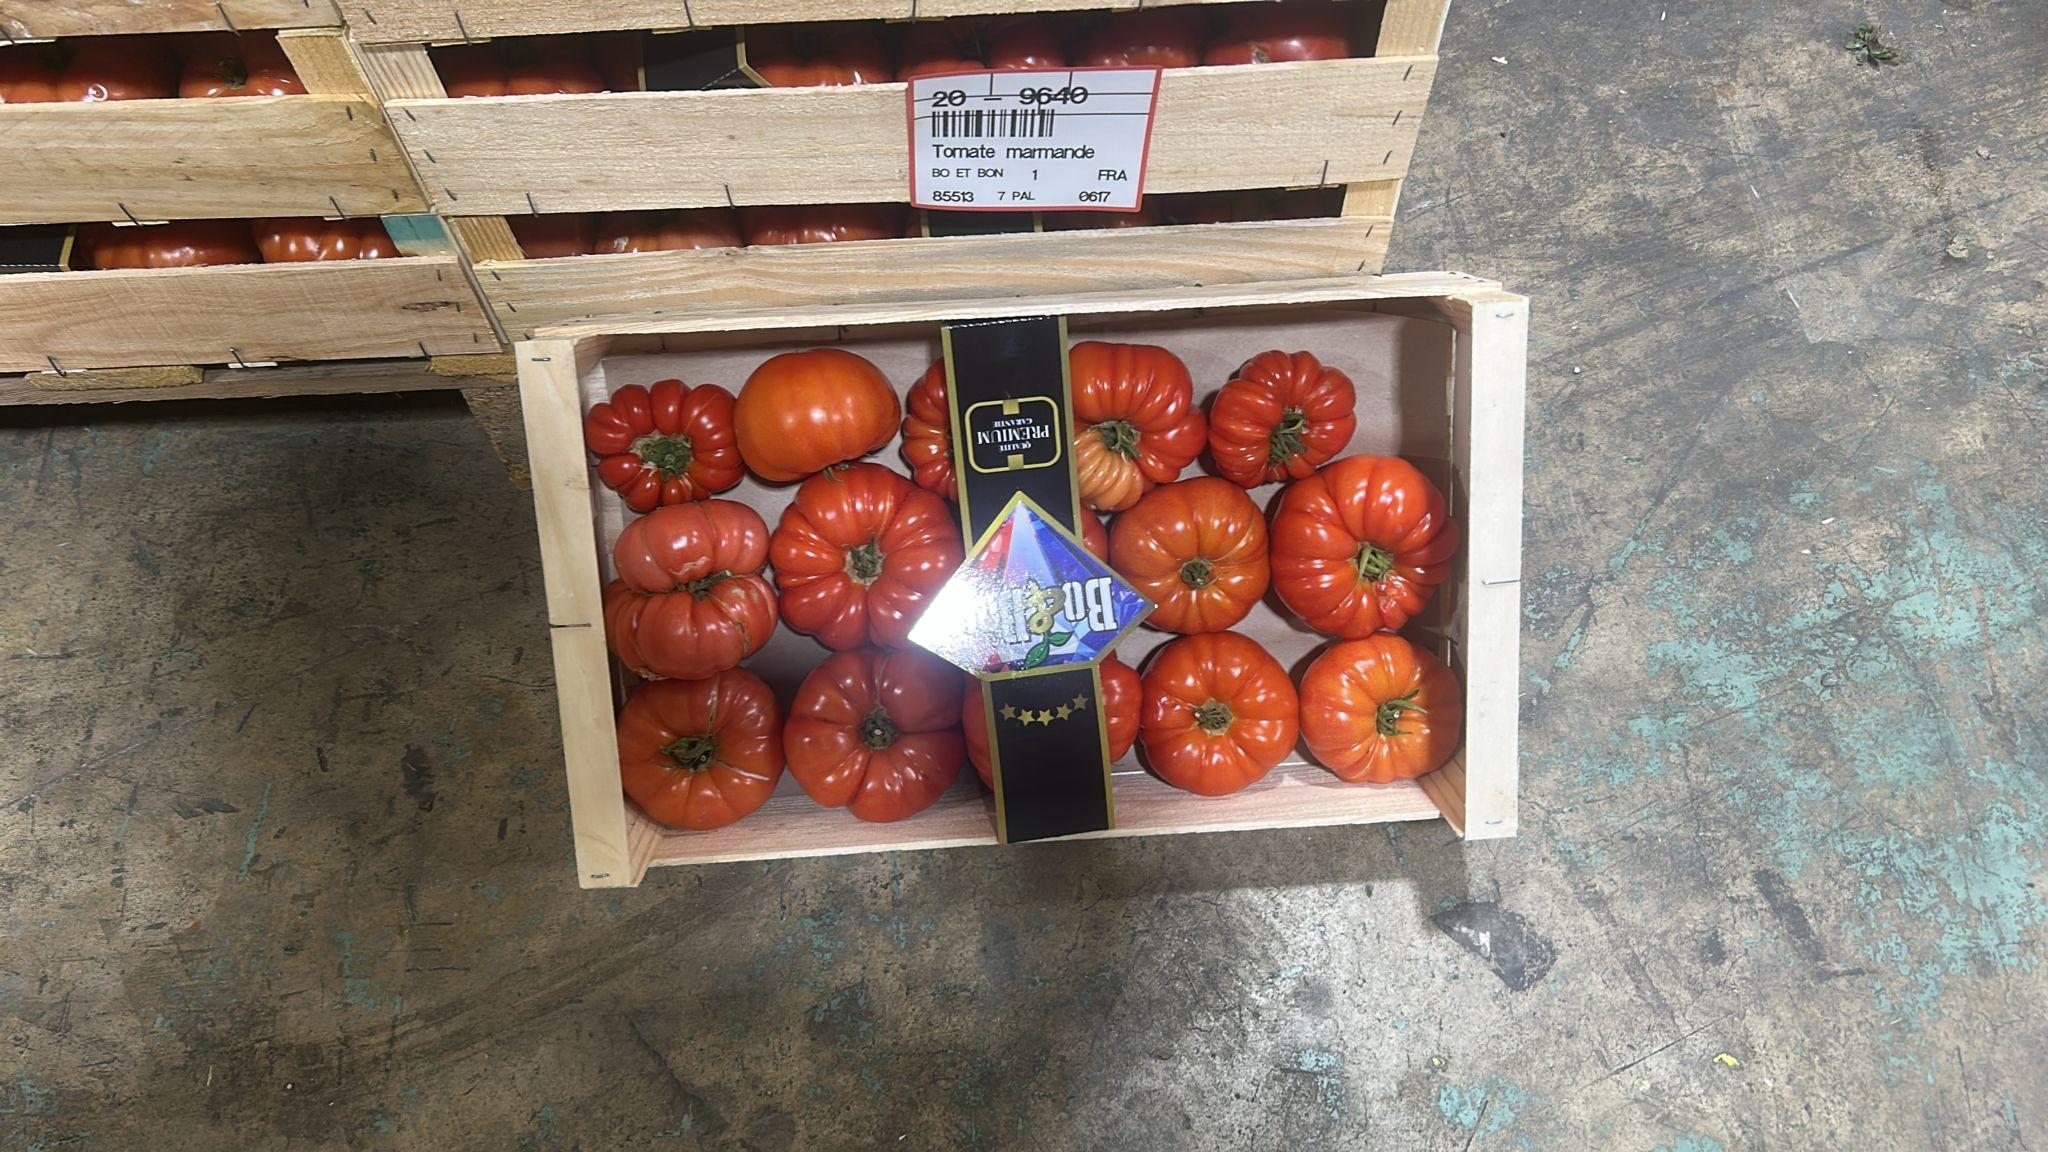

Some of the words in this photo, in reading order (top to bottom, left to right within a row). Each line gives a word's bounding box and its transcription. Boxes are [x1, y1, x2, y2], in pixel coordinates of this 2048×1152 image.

[931, 89, 967, 108] 20
[1018, 86, 1089, 106] 9640
[932, 144, 996, 159] Tomate
[1006, 144, 1095, 159] marmande
[932, 168, 950, 178] BO
[956, 168, 971, 178] ET
[977, 168, 1004, 178] BON
[1032, 169, 1039, 181] 1
[1097, 169, 1128, 181] FRA
[932, 190, 975, 203] 85513
[998, 191, 1005, 201] 7
[1012, 191, 1036, 201] PAL
[1078, 190, 1112, 203] 0617
[977, 425, 1050, 445] PREMIUM
